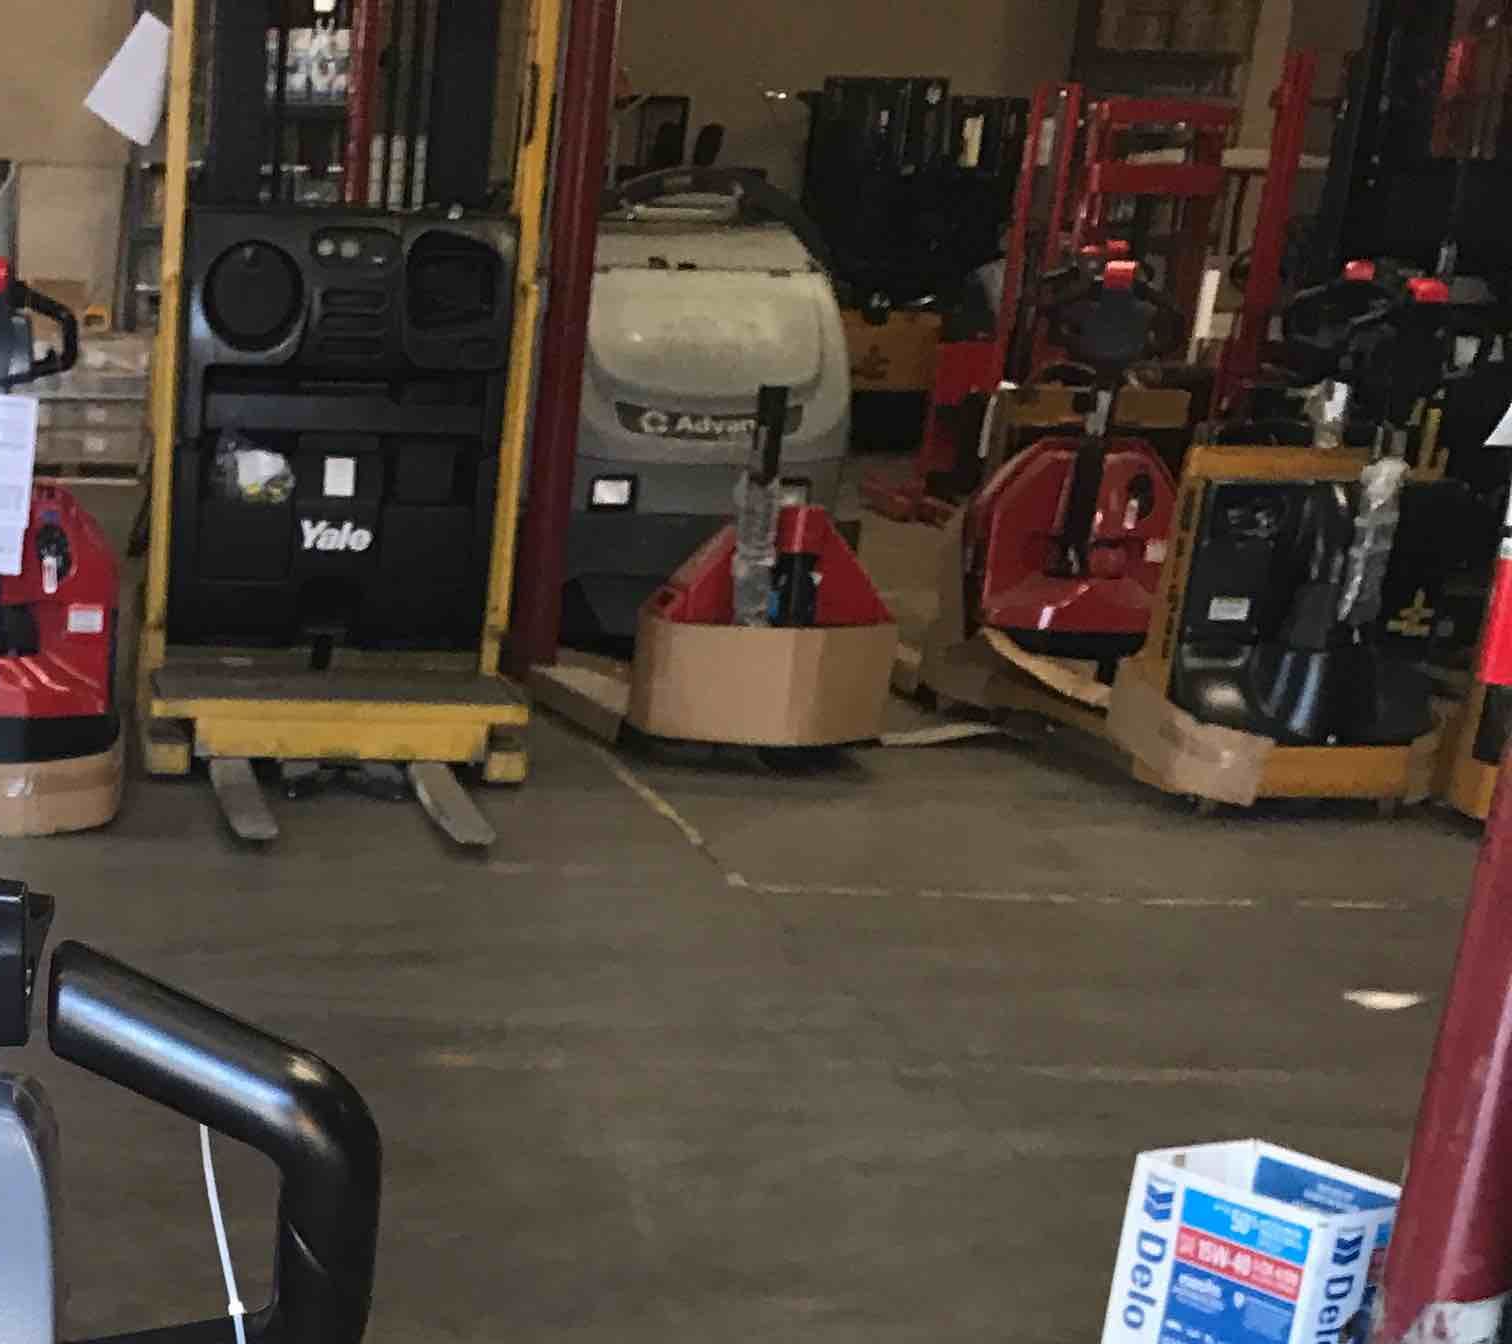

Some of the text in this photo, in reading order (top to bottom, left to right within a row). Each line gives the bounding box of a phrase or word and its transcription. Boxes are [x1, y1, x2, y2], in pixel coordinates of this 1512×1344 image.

[675, 414, 757, 435] Advan
[300, 519, 373, 551] Yale
[1122, 1230, 1168, 1331] Delo
